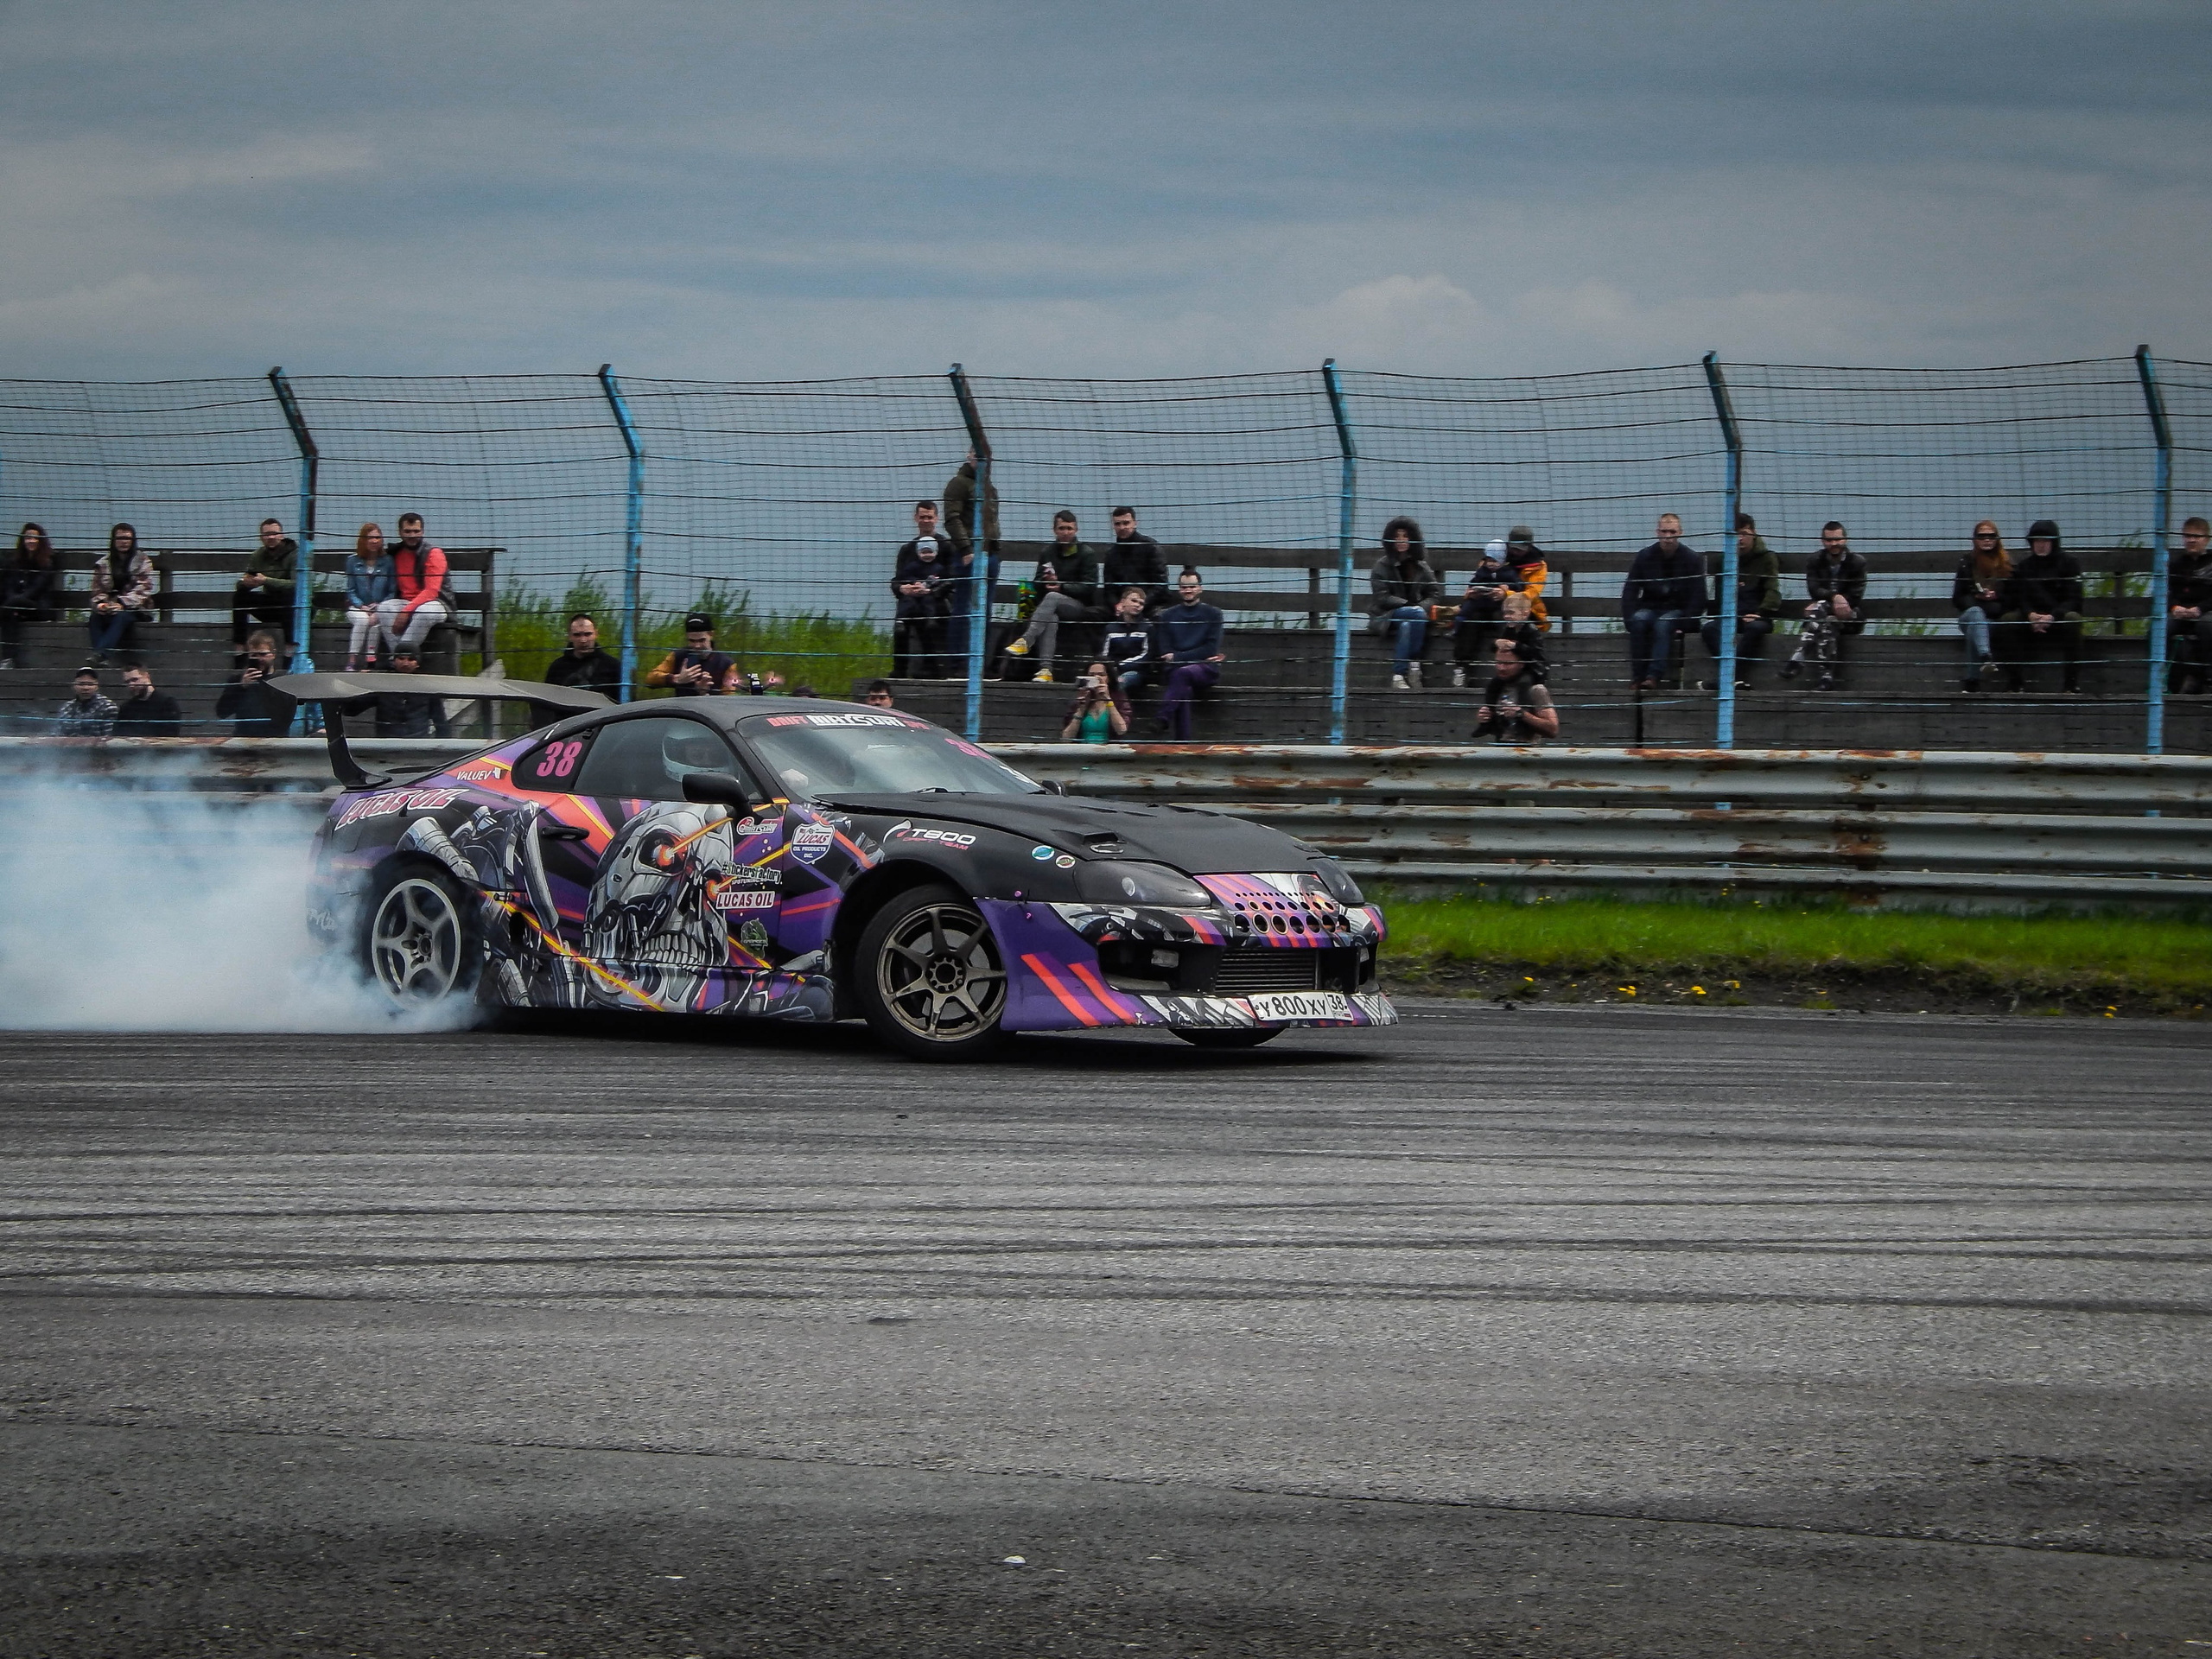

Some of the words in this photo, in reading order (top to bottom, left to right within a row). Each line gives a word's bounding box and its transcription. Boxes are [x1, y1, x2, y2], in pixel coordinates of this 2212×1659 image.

[766, 715, 809, 727] DRIFT
[536, 741, 583, 777] 38
[456, 770, 491, 781] VALUEV
[406, 788, 470, 810] OIL
[797, 834, 830, 843] LUCAS
[912, 829, 976, 845] T800
[939, 840, 969, 851] TEAM
[717, 893, 753, 907] LUCAS
[755, 893, 772, 906] OIL
[1327, 994, 1344, 1011] 38
